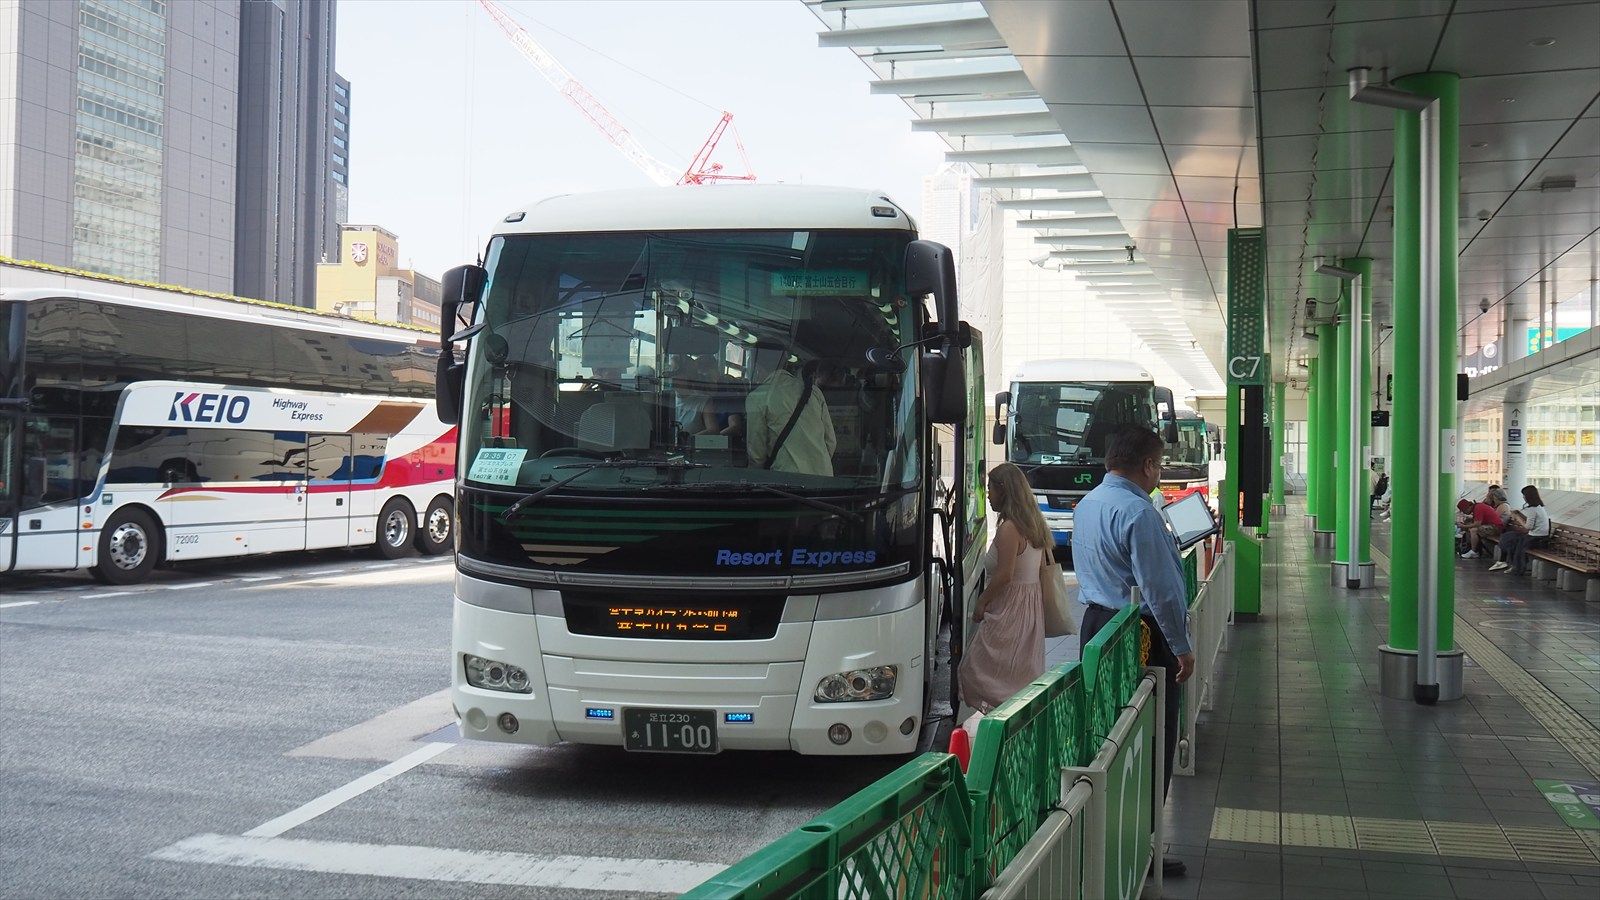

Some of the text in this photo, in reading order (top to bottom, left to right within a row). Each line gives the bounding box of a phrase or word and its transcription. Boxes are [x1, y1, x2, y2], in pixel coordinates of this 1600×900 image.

[1229, 356, 1261, 378] C7
[168, 392, 250, 424] KEIO
[272, 398, 308, 411] Highway
[291, 411, 324, 422] Express
[1074, 473, 1092, 484] JR
[175, 534, 199, 545] 72002
[716, 548, 877, 567] Resort Express
[646, 723, 711, 749] 11-00
[1118, 725, 1143, 900] C7
